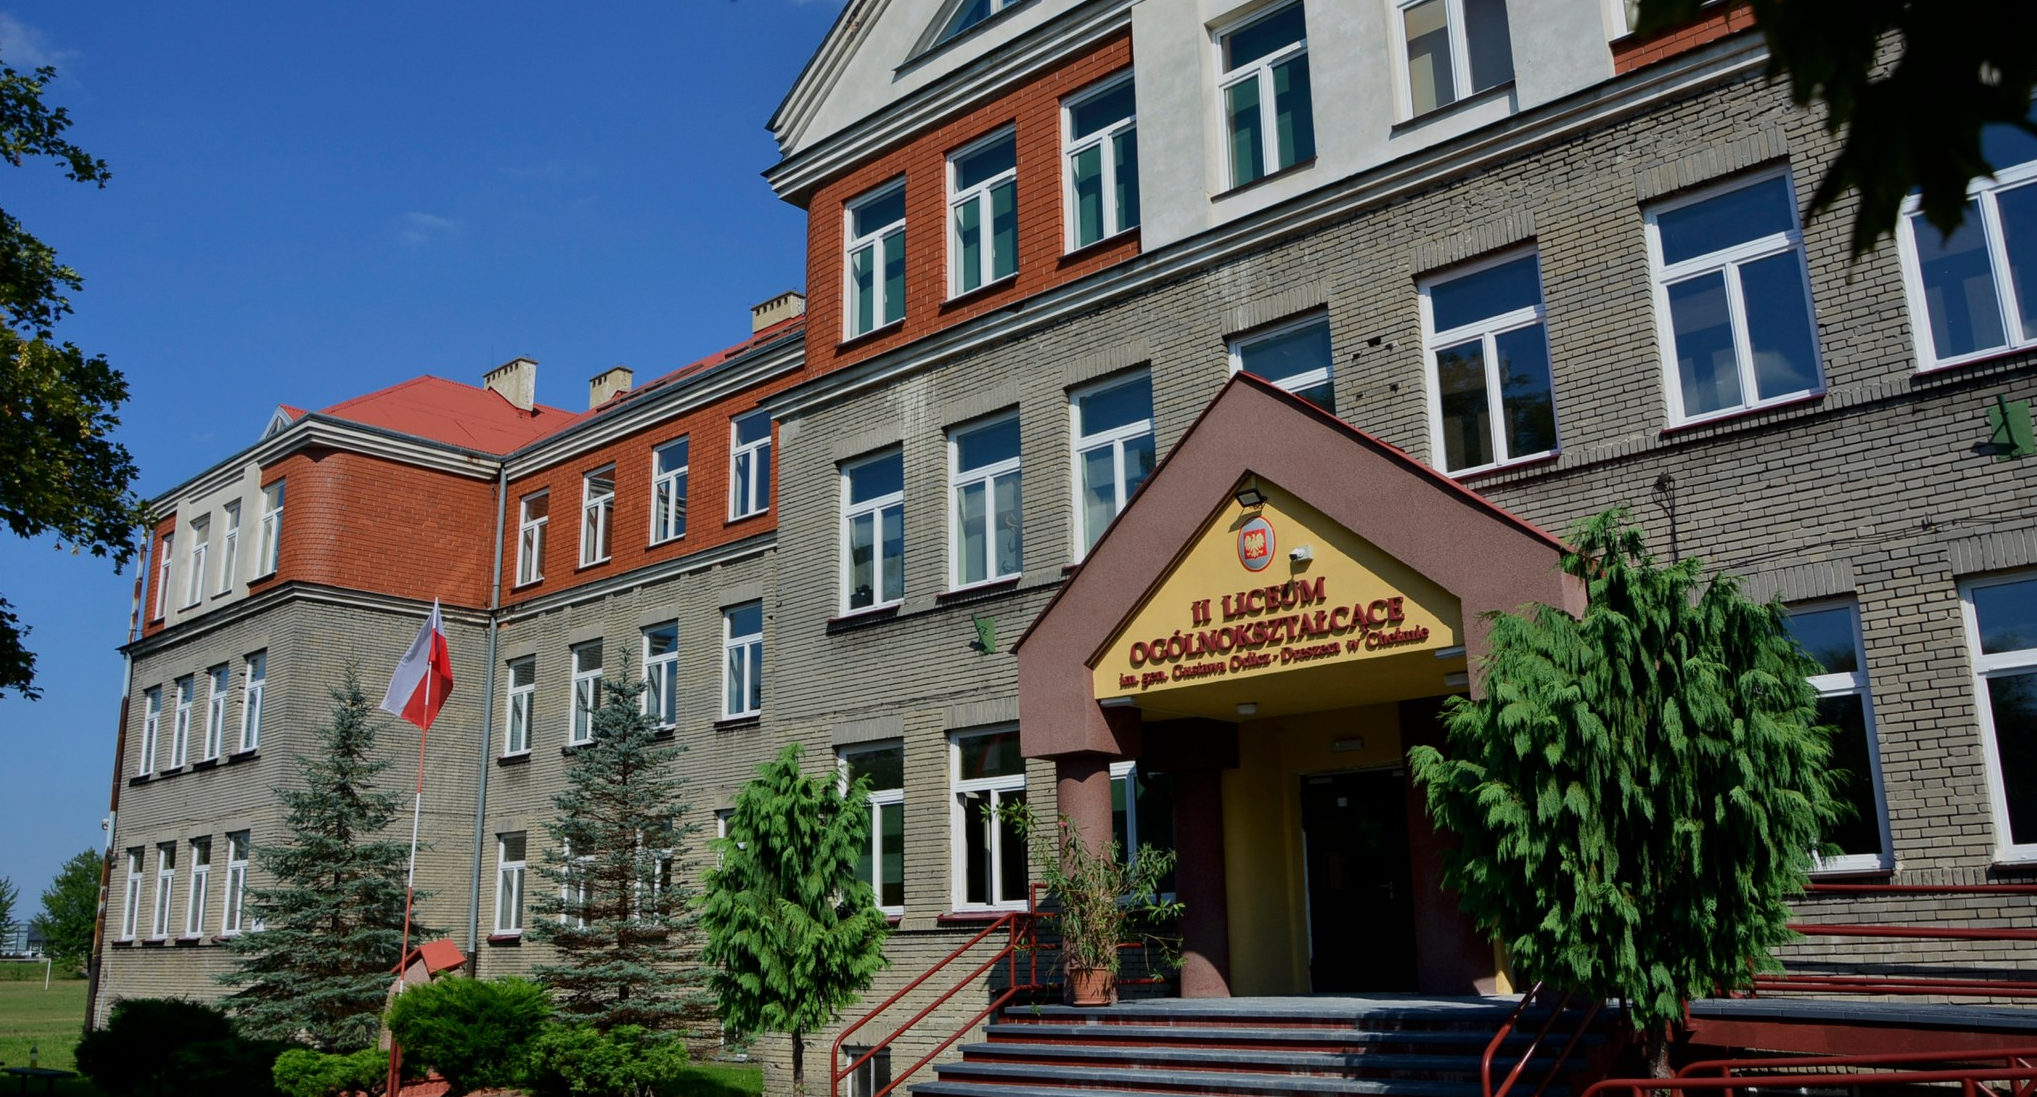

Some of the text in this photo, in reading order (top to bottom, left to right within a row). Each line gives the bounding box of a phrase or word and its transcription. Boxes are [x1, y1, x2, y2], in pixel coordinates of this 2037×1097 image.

[1190, 576, 1327, 624] II LICEUM
[1129, 596, 1405, 665] OGÓLNOKSZTAŁCĄCE
[1141, 670, 1169, 689] gen.
[1172, 661, 1227, 678] Gustawa
